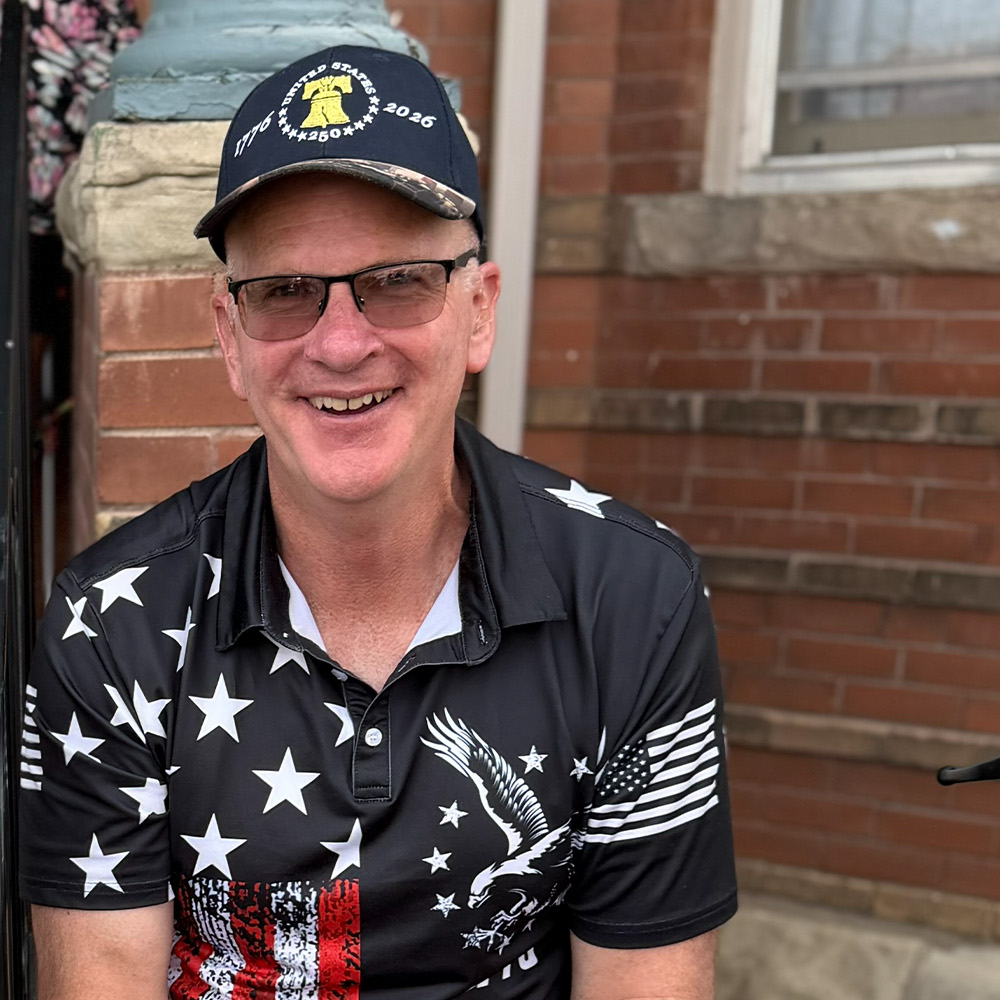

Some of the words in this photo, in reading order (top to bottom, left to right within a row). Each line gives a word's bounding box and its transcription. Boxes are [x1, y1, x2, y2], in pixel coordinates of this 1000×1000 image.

[281, 64, 327, 107] UNITED
[331, 62, 376, 95] STATES
[382, 102, 437, 129] 2026
[233, 110, 275, 158] 1776
[307, 128, 341, 142] 250
